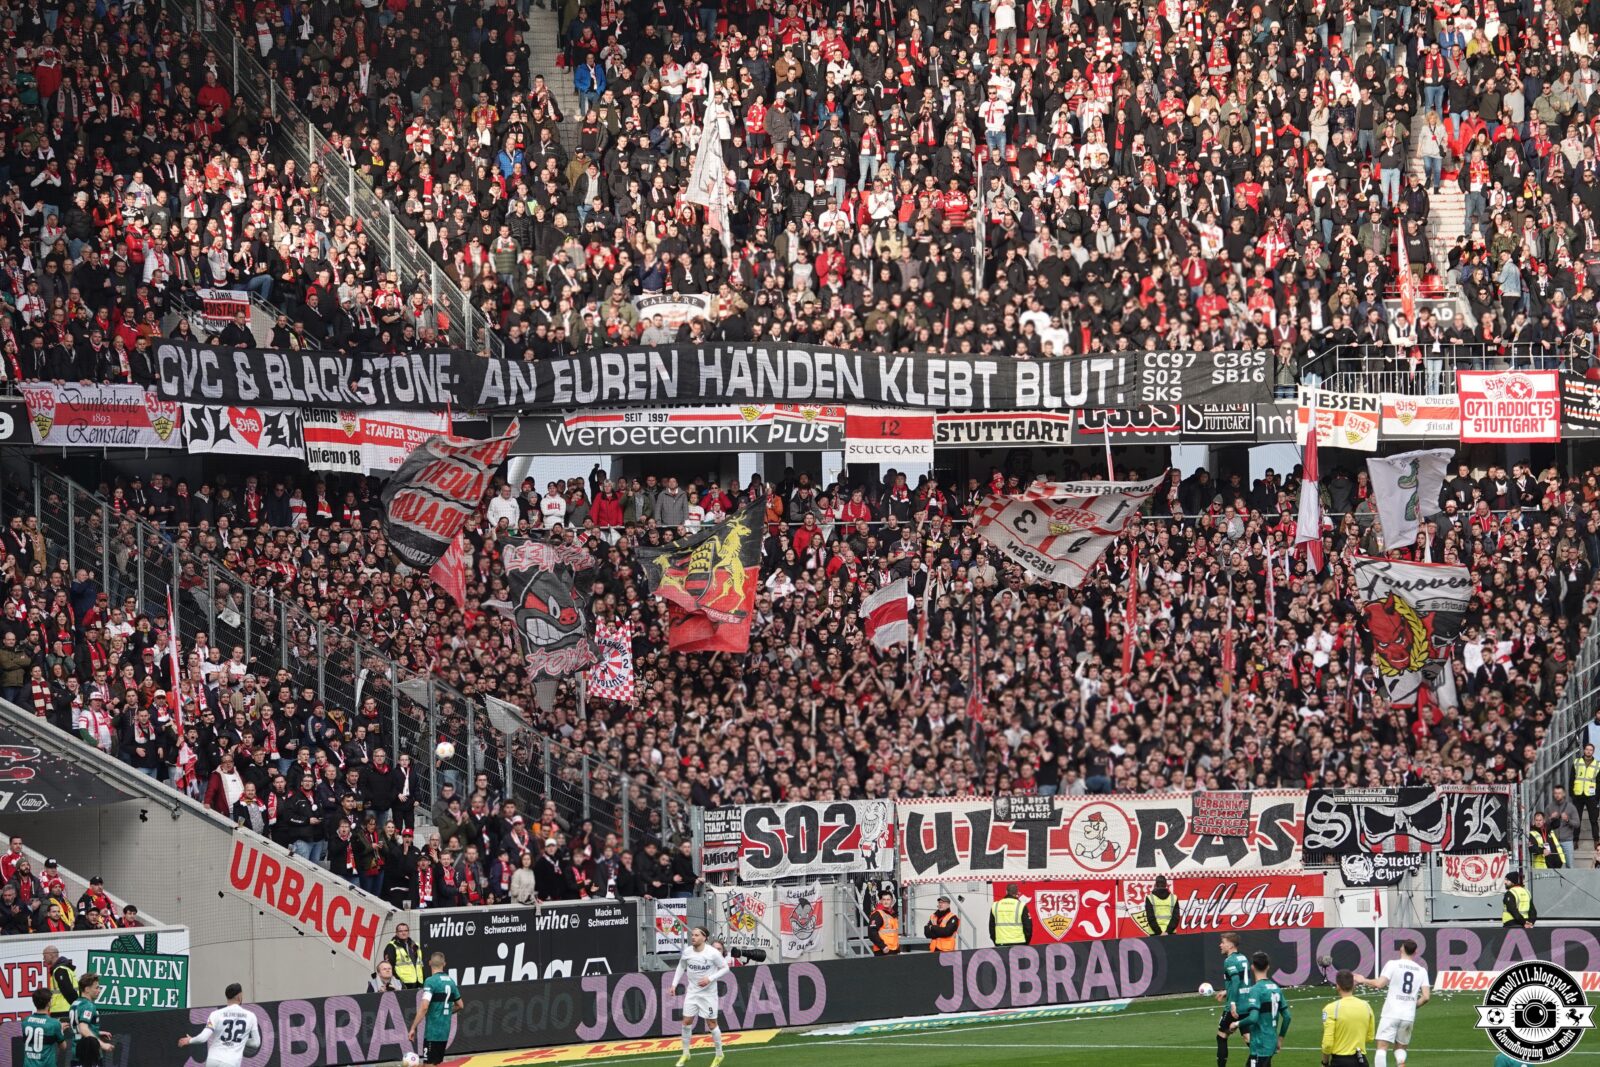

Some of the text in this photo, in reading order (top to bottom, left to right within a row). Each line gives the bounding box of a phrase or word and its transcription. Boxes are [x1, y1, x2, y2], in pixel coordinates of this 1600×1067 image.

[1142, 351, 1197, 368] CC97
[1213, 351, 1267, 367] C36S
[158, 344, 225, 399] CVC
[232, 351, 260, 400] &
[477, 357, 537, 406] AN
[553, 350, 678, 404] EUREN
[697, 346, 866, 401] HÄNDEN
[878, 356, 998, 409] KLEBT
[1015, 357, 1126, 409] BLUT!
[1211, 367, 1267, 384] SB16
[1141, 385, 1183, 402] SKS
[302, 407, 338, 424] Glems
[624, 412, 670, 423] SEIT 1997
[1466, 401, 1554, 417] 0711 ADDICTS
[92, 413, 112, 425] 1893
[880, 419, 901, 437] 12
[1473, 418, 1546, 433] STUTTGART
[365, 422, 405, 440] STAUFER
[545, 422, 830, 447] Werbetechnik PLUS
[936, 420, 1069, 443] STUTTGART
[308, 447, 361, 466] Inferno 18
[849, 444, 929, 455] STUTTGART
[1010, 796, 1050, 805] DU BIST
[1010, 804, 1051, 813] IMMER
[1452, 880, 1498, 896] Stuttgart
[229, 840, 381, 961] URBACH
[1268, 884, 1316, 928] die
[491, 914, 520, 924] Made im
[534, 909, 569, 932] wiha
[594, 906, 622, 917] Made im
[429, 917, 465, 938] wiha
[483, 924, 528, 935] Schwarzwald
[587, 916, 629, 927] Schwarzwald
[448, 942, 573, 985] wiha
[1271, 927, 1600, 987] JOBRAD
[91, 955, 184, 982] TANNEN
[934, 937, 1154, 1014] JOBRAD
[1402, 971, 1414, 994] 8
[94, 978, 180, 1010] ZÄPFLE
[443, 984, 452, 1009] 2
[576, 961, 827, 1042] JOBRAD
[24, 1026, 44, 1053] 20
[220, 1019, 247, 1043] 32
